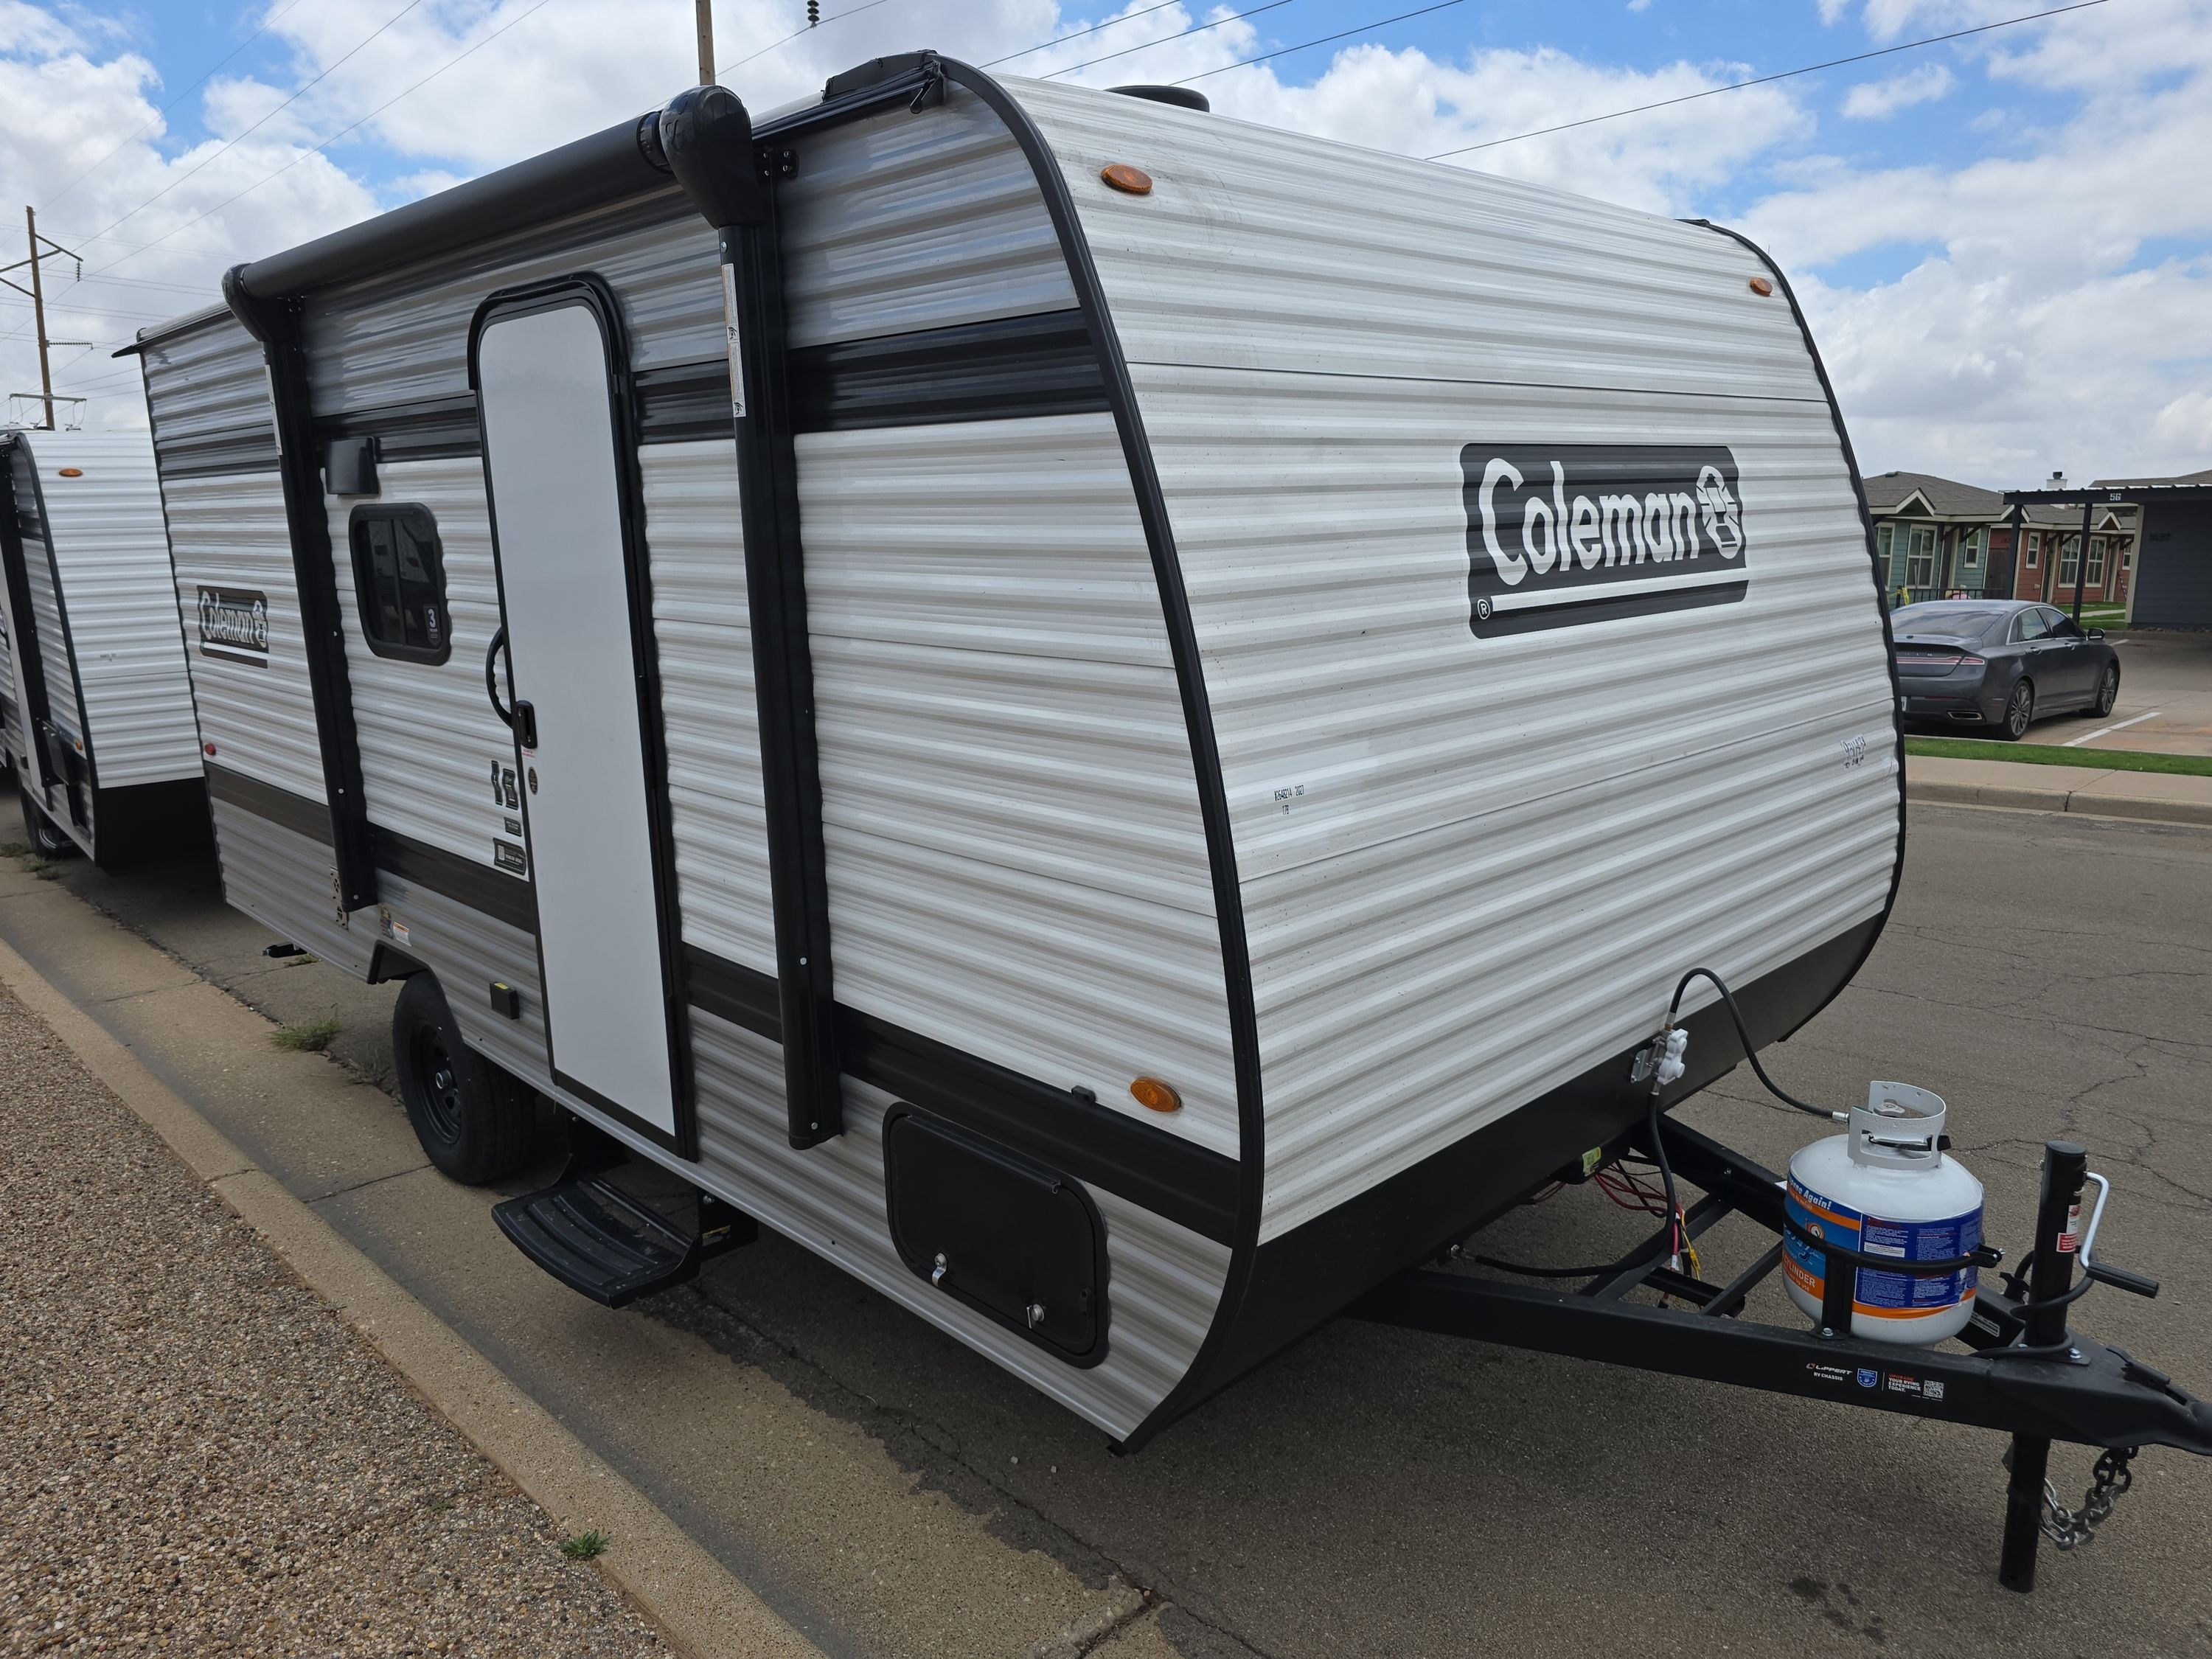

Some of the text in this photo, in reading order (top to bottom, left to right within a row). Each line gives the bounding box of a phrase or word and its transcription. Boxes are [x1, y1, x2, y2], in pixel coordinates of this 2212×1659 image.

[2110, 493, 2121, 501] 56
[1478, 457, 1699, 585] Coleman
[200, 591, 254, 644] Coleman
[428, 608, 437, 628] 3
[1803, 1189, 1832, 1210] Again!
[1784, 1254, 1816, 1288] CYLINDER
[1821, 1373, 1843, 1381] CHASSIS
[1888, 1381, 1921, 1391] EXPERIENCE
